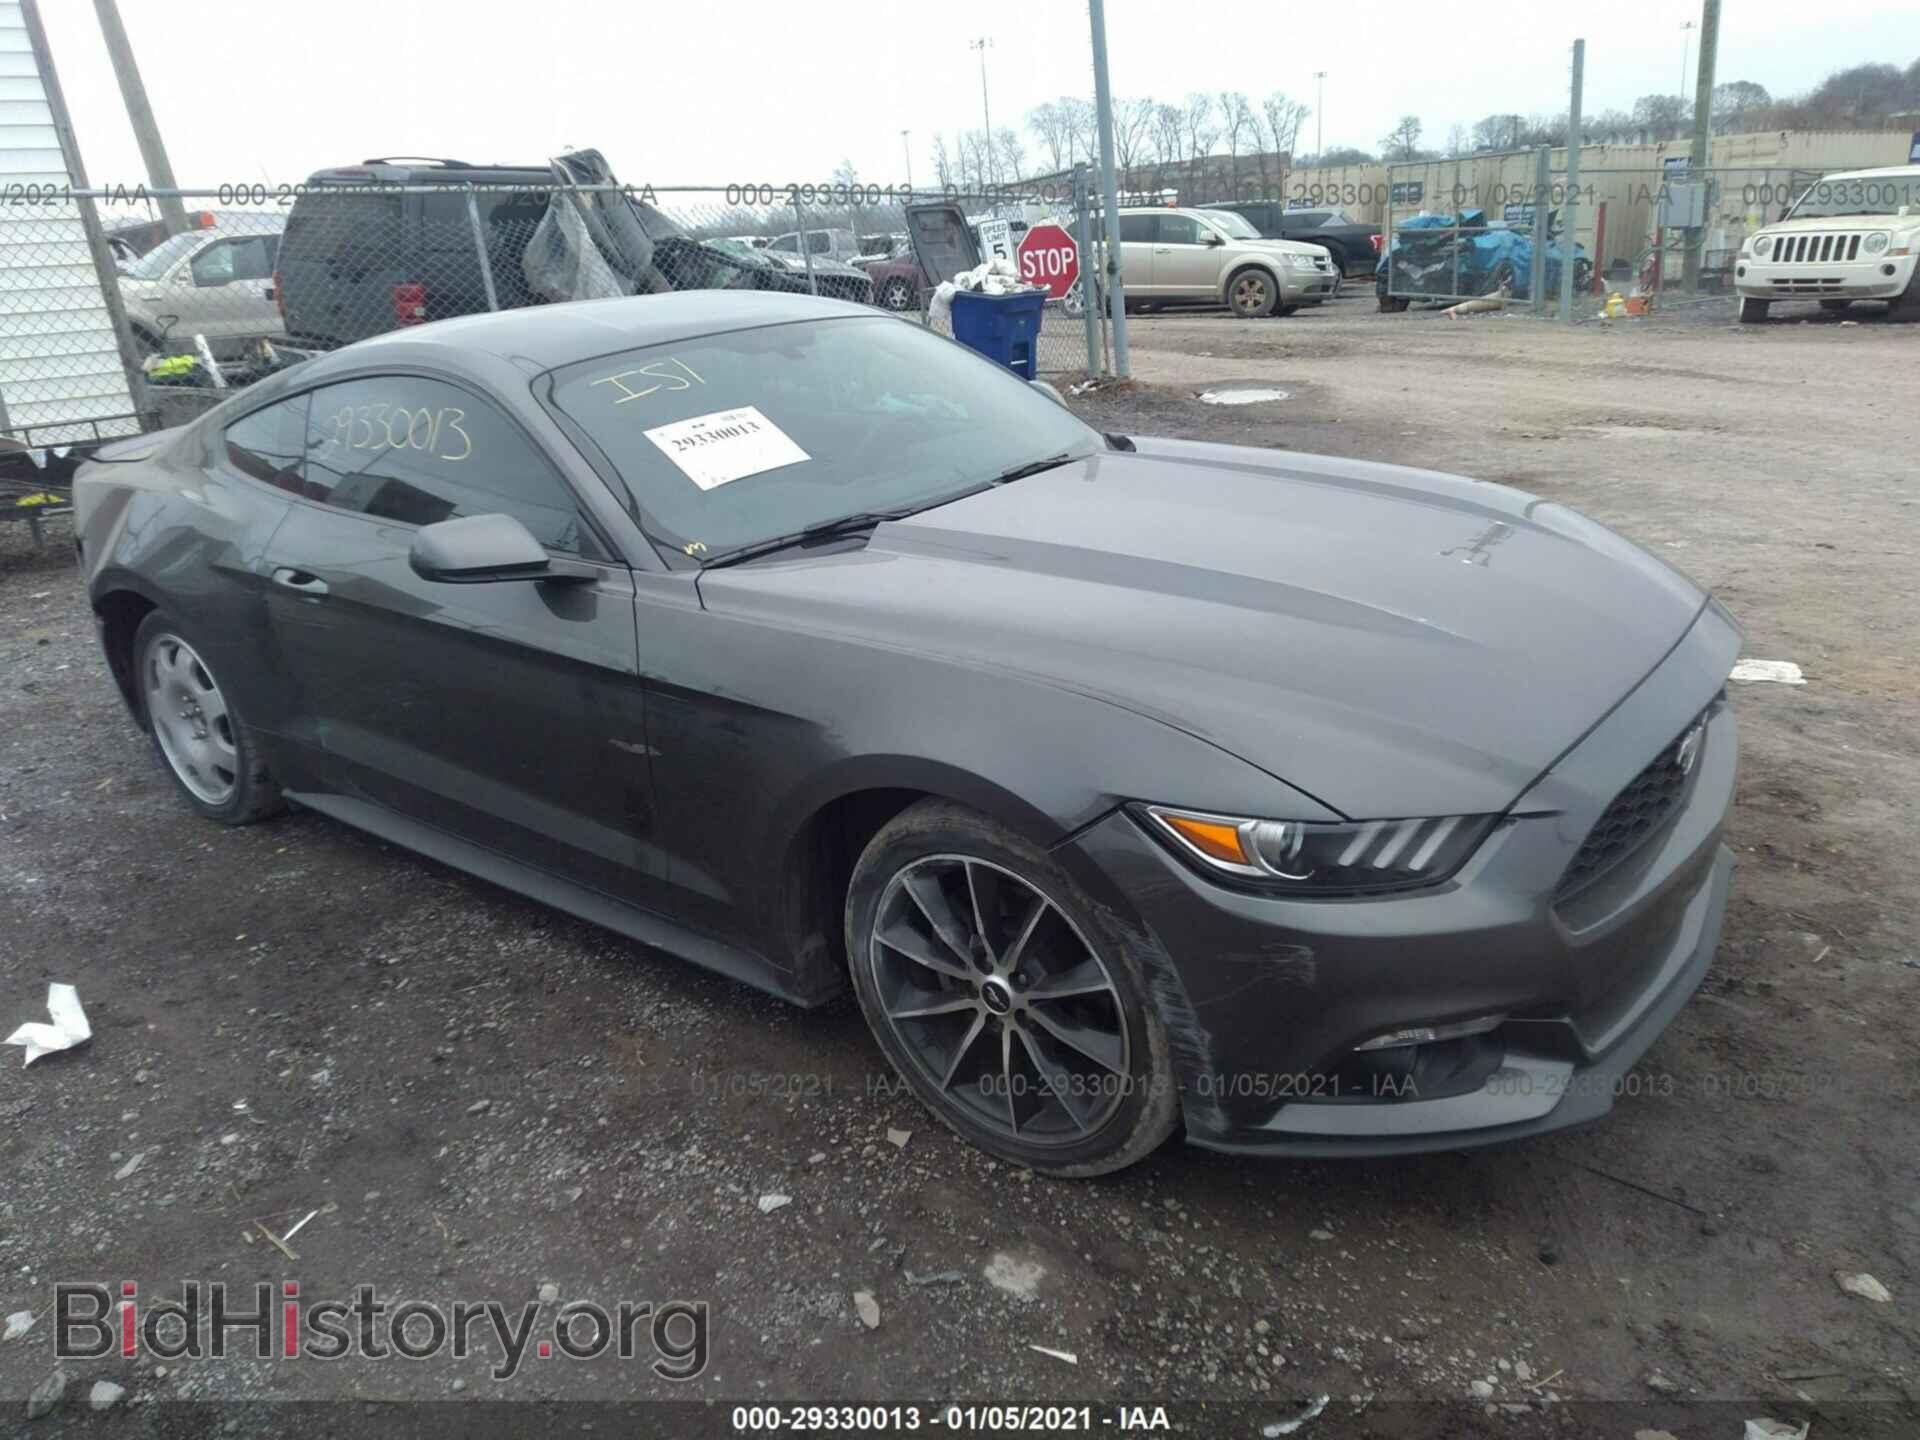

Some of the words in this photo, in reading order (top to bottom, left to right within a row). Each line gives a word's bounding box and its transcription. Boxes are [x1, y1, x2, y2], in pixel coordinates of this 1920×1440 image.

[983, 222, 1007, 235] SPEED
[986, 232, 1006, 243] LIMIT
[993, 243, 1007, 260] 5
[1023, 247, 1074, 278] STOP
[671, 420, 763, 452] 29330013
